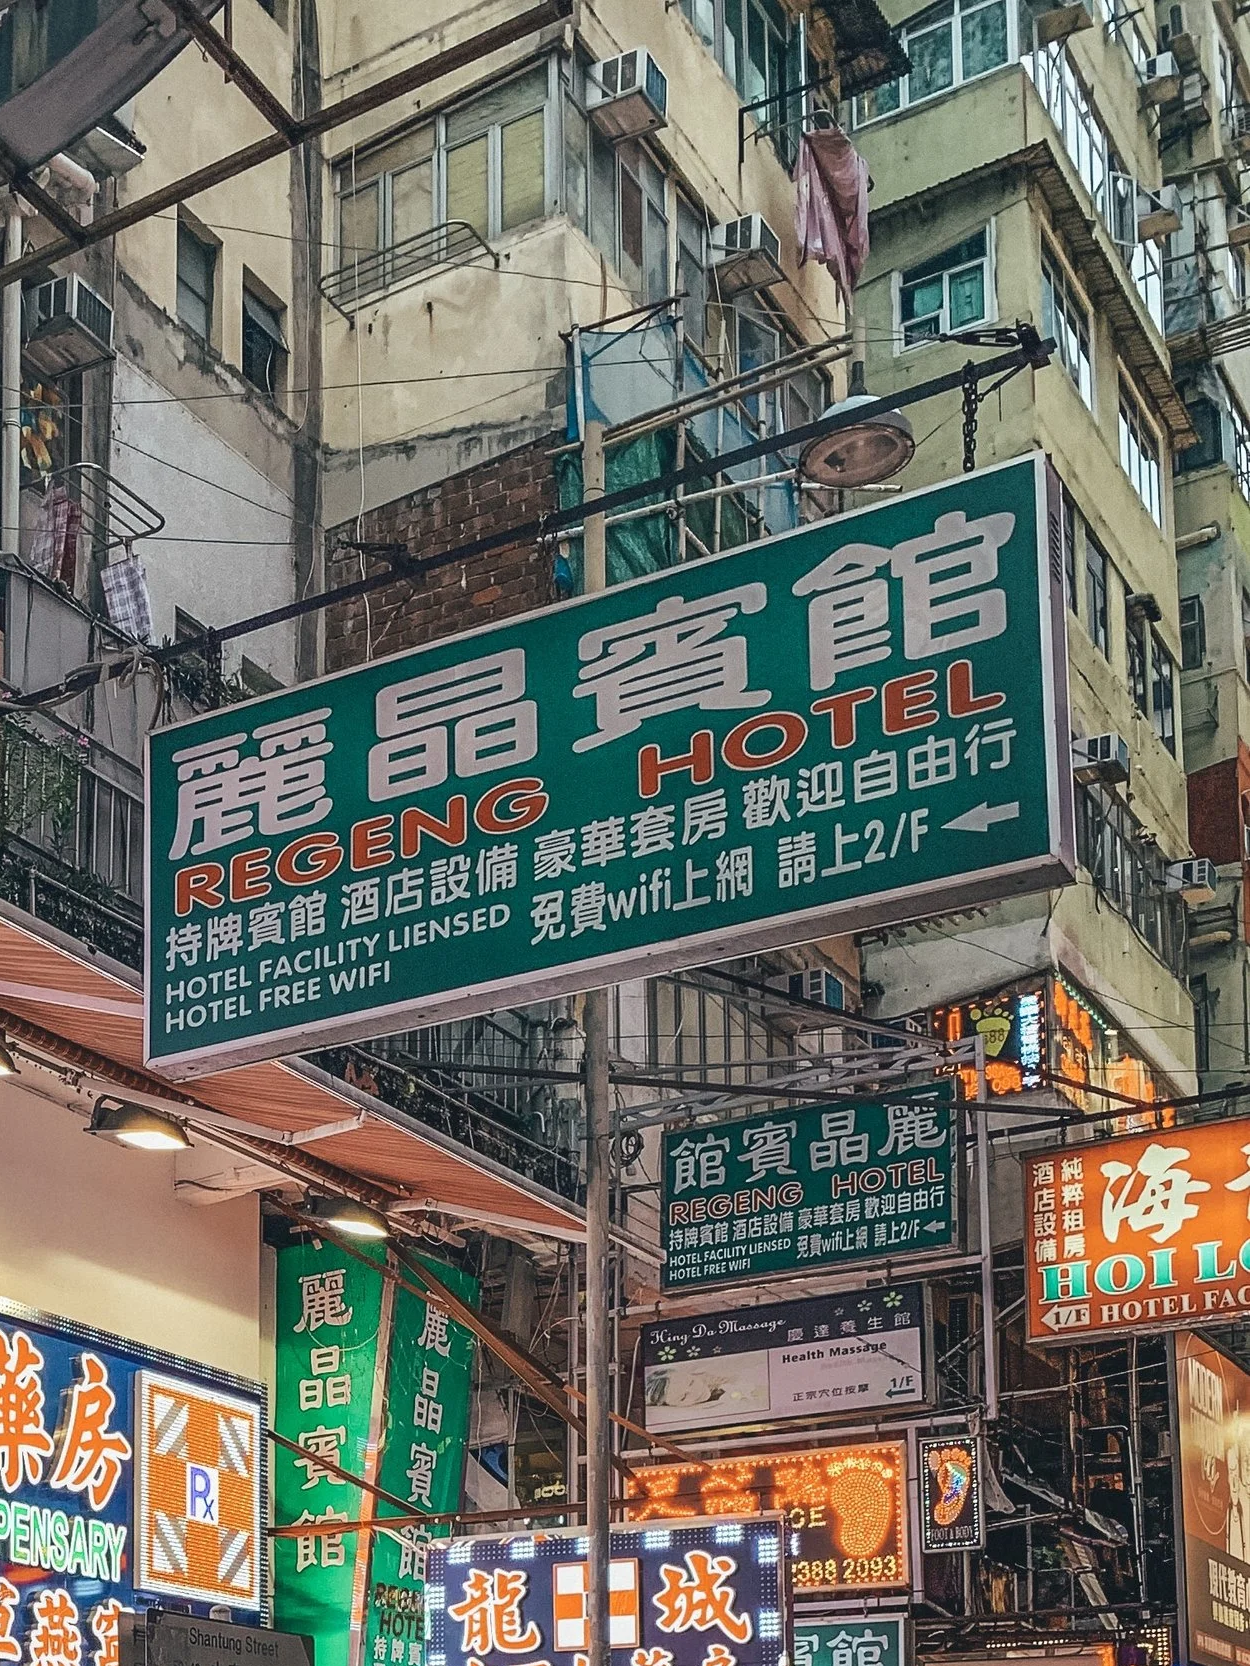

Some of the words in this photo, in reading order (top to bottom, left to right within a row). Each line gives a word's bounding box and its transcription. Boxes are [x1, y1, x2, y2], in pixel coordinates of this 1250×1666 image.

[168, 509, 1017, 861] 麗晶賓館
[174, 777, 550, 918] REGENG
[637, 659, 1008, 798] HOTEL
[165, 891, 327, 974] 持牌賓館
[342, 845, 519, 931] 酒店設備
[534, 789, 729, 880] 豪華套房
[741, 721, 1019, 828] 歡迎自由行
[777, 809, 931, 889] 請上2/F
[165, 964, 252, 1006] HOTEL
[259, 934, 380, 989] FACILITY
[387, 904, 511, 957] LIENSED
[165, 998, 252, 1034] HOTEL
[259, 983, 323, 1021] FREE
[331, 961, 391, 1004] WIFI
[669, 1182, 804, 1227] REGENG
[832, 1157, 945, 1198] HOTEL
[669, 1222, 728, 1250] 持牌賓館
[732, 1212, 794, 1242] 酒店設備
[798, 1200, 860, 1231] 豪華套房
[864, 1186, 945, 1220] 歡迎自由行
[1033, 1161, 1057, 1263] 酒店設備
[1061, 1157, 1086, 1259] 純粹租房
[1100, 1143, 1250, 1243] 海
[669, 1254, 702, 1267] HOTEL
[704, 1244, 747, 1261] FACILITY
[750, 1238, 791, 1255] LIENSED
[669, 1267, 702, 1281] HOTEL
[704, 1262, 726, 1276] FREE
[728, 1259, 751, 1273] WIFI
[1038, 1248, 1178, 1305] HOI
[1192, 1240, 1250, 1283] L
[718, 1318, 786, 1336] Massage
[1052, 1307, 1087, 1325] 1/F
[1100, 1294, 1197, 1324] HOTEL
[782, 1347, 824, 1363] Health
[829, 1340, 887, 1357] Massage
[890, 1376, 914, 1388] 1/F
[294, 1270, 352, 1573] 麗晶賓館
[843, 1556, 895, 1577] 2093
[380, 1613, 424, 1641] HOTE
[448, 1568, 541, 1655] 龍
[653, 1550, 753, 1644] 城
[189, 1627, 241, 1655] Shantung
[245, 1636, 278, 1658] Street
